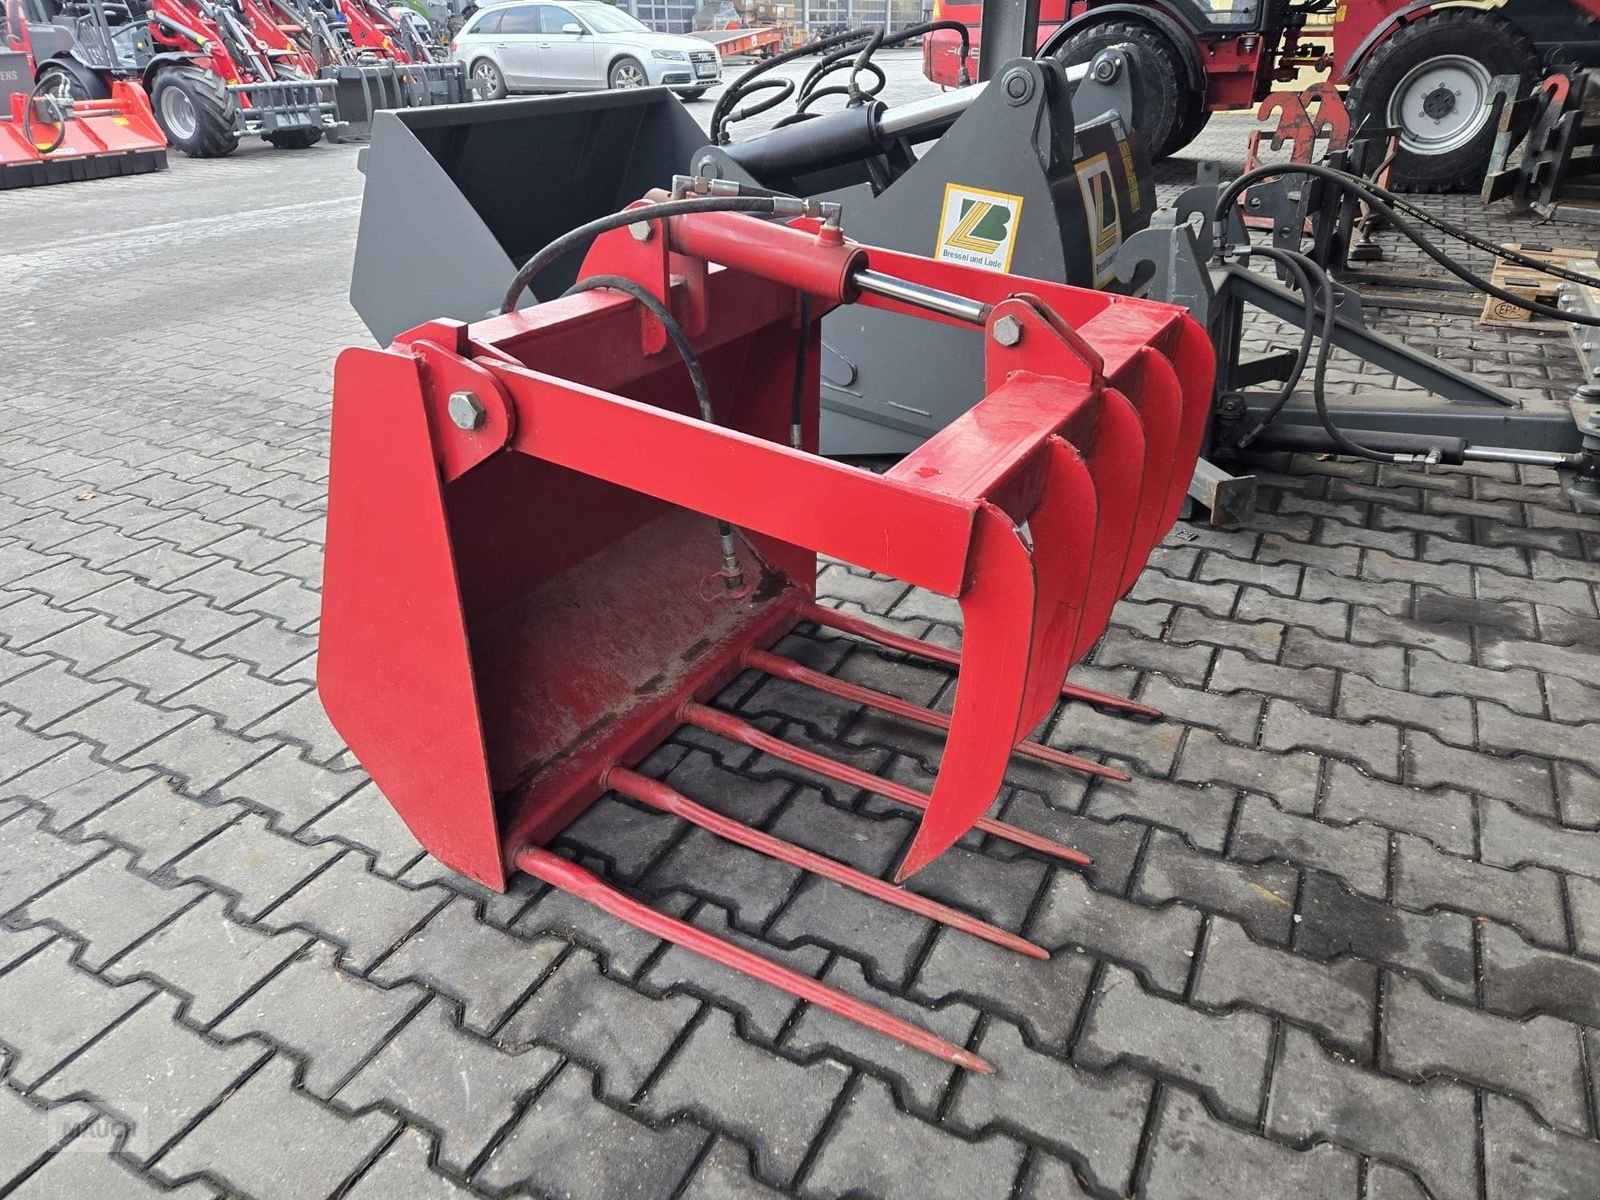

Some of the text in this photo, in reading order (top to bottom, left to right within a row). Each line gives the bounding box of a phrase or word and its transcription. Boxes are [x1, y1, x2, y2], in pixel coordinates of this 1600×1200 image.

[943, 249, 1002, 268] Bressel und Lade
